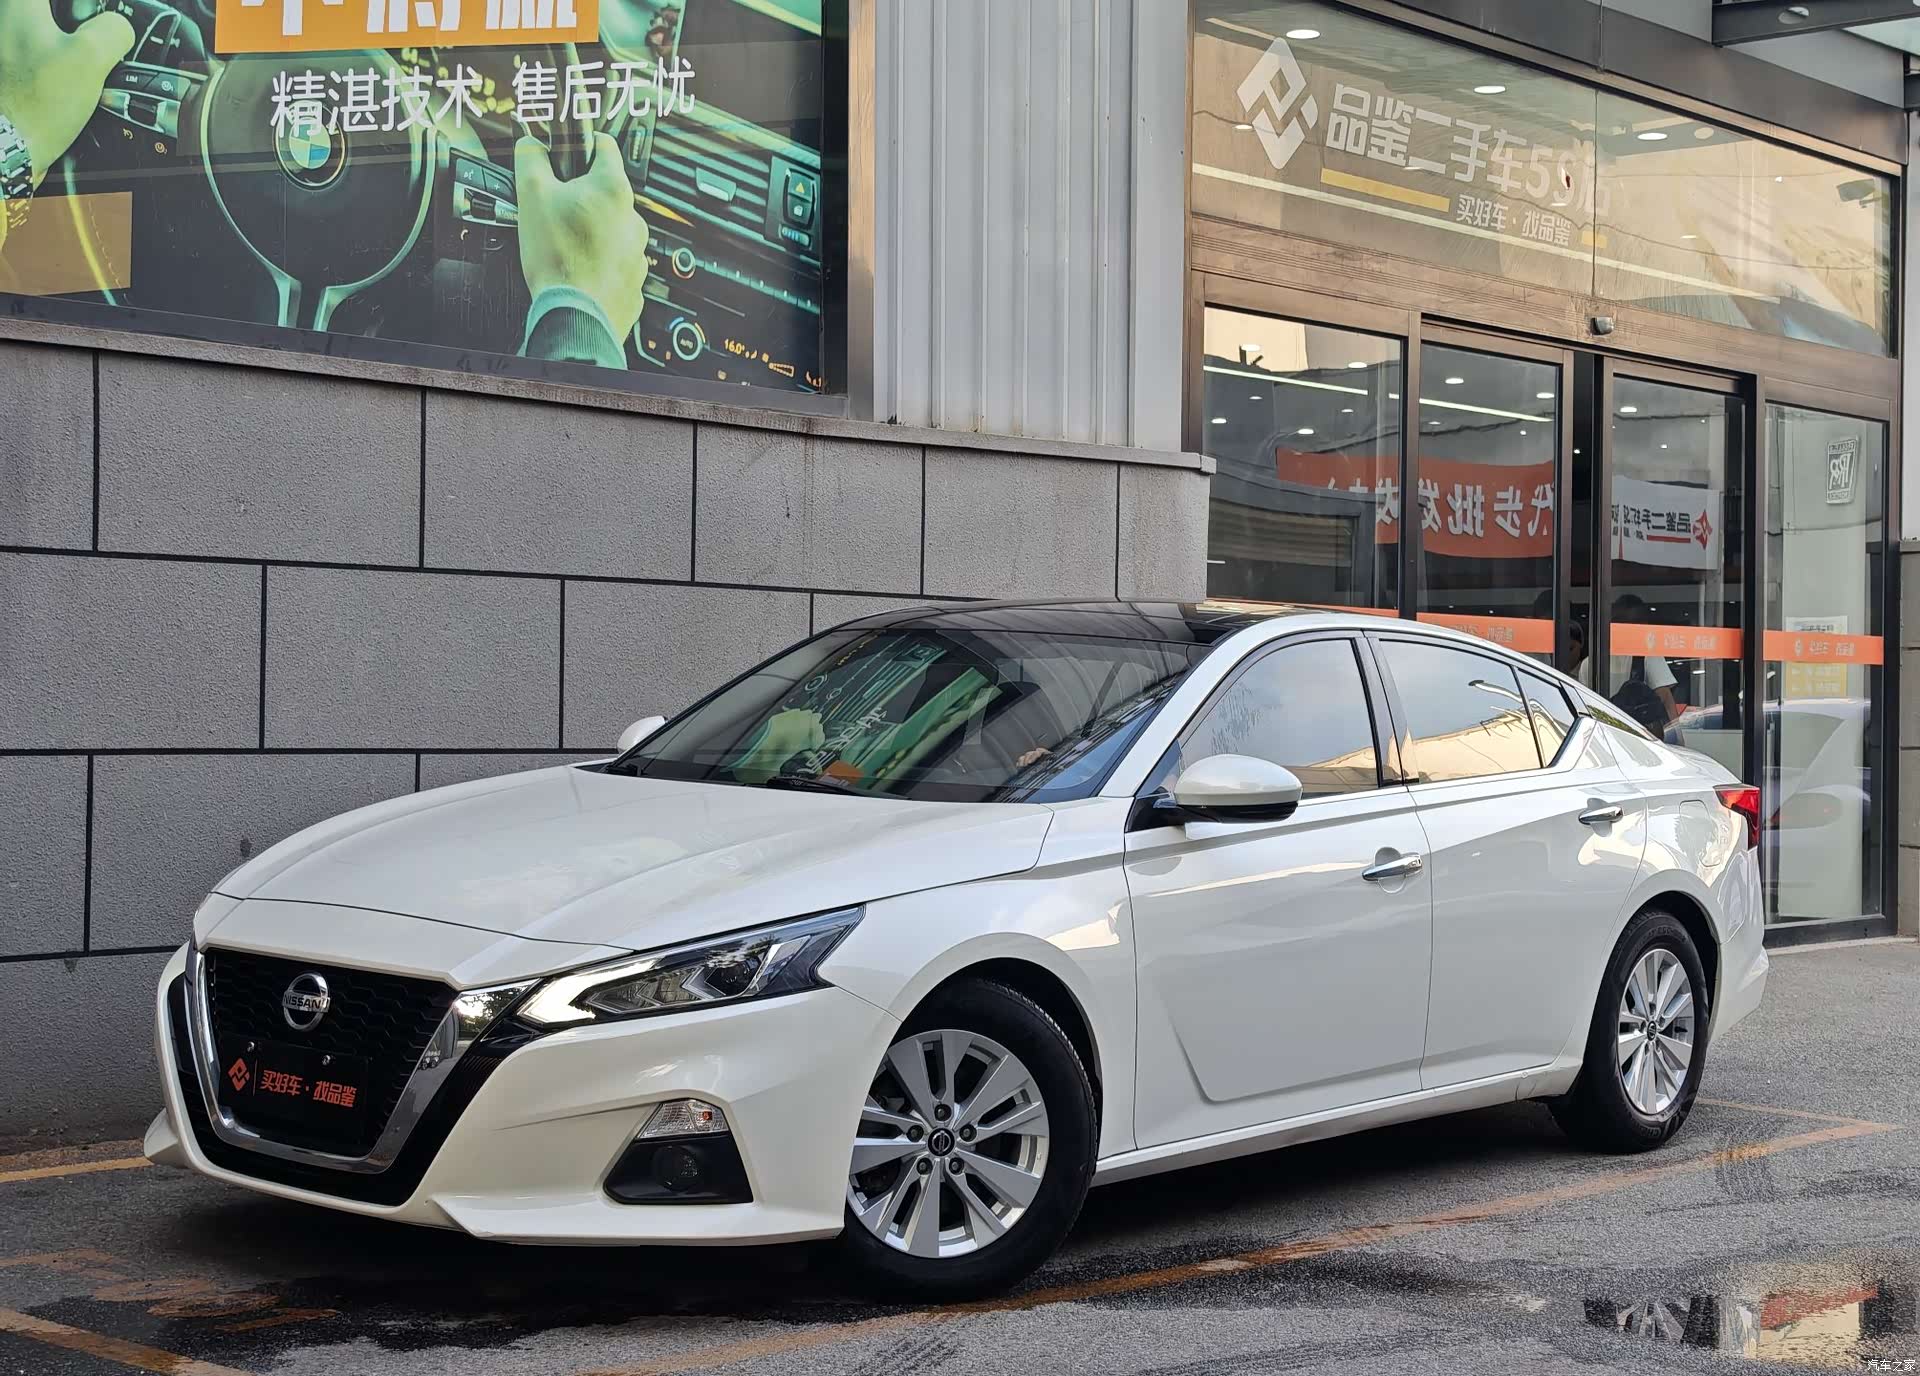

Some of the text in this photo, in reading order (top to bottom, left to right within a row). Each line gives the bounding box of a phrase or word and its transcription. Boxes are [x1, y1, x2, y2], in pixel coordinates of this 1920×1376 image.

[270, 57, 696, 137] 精湛技术 售后无忧
[284, 994, 329, 1011] NISSAN
